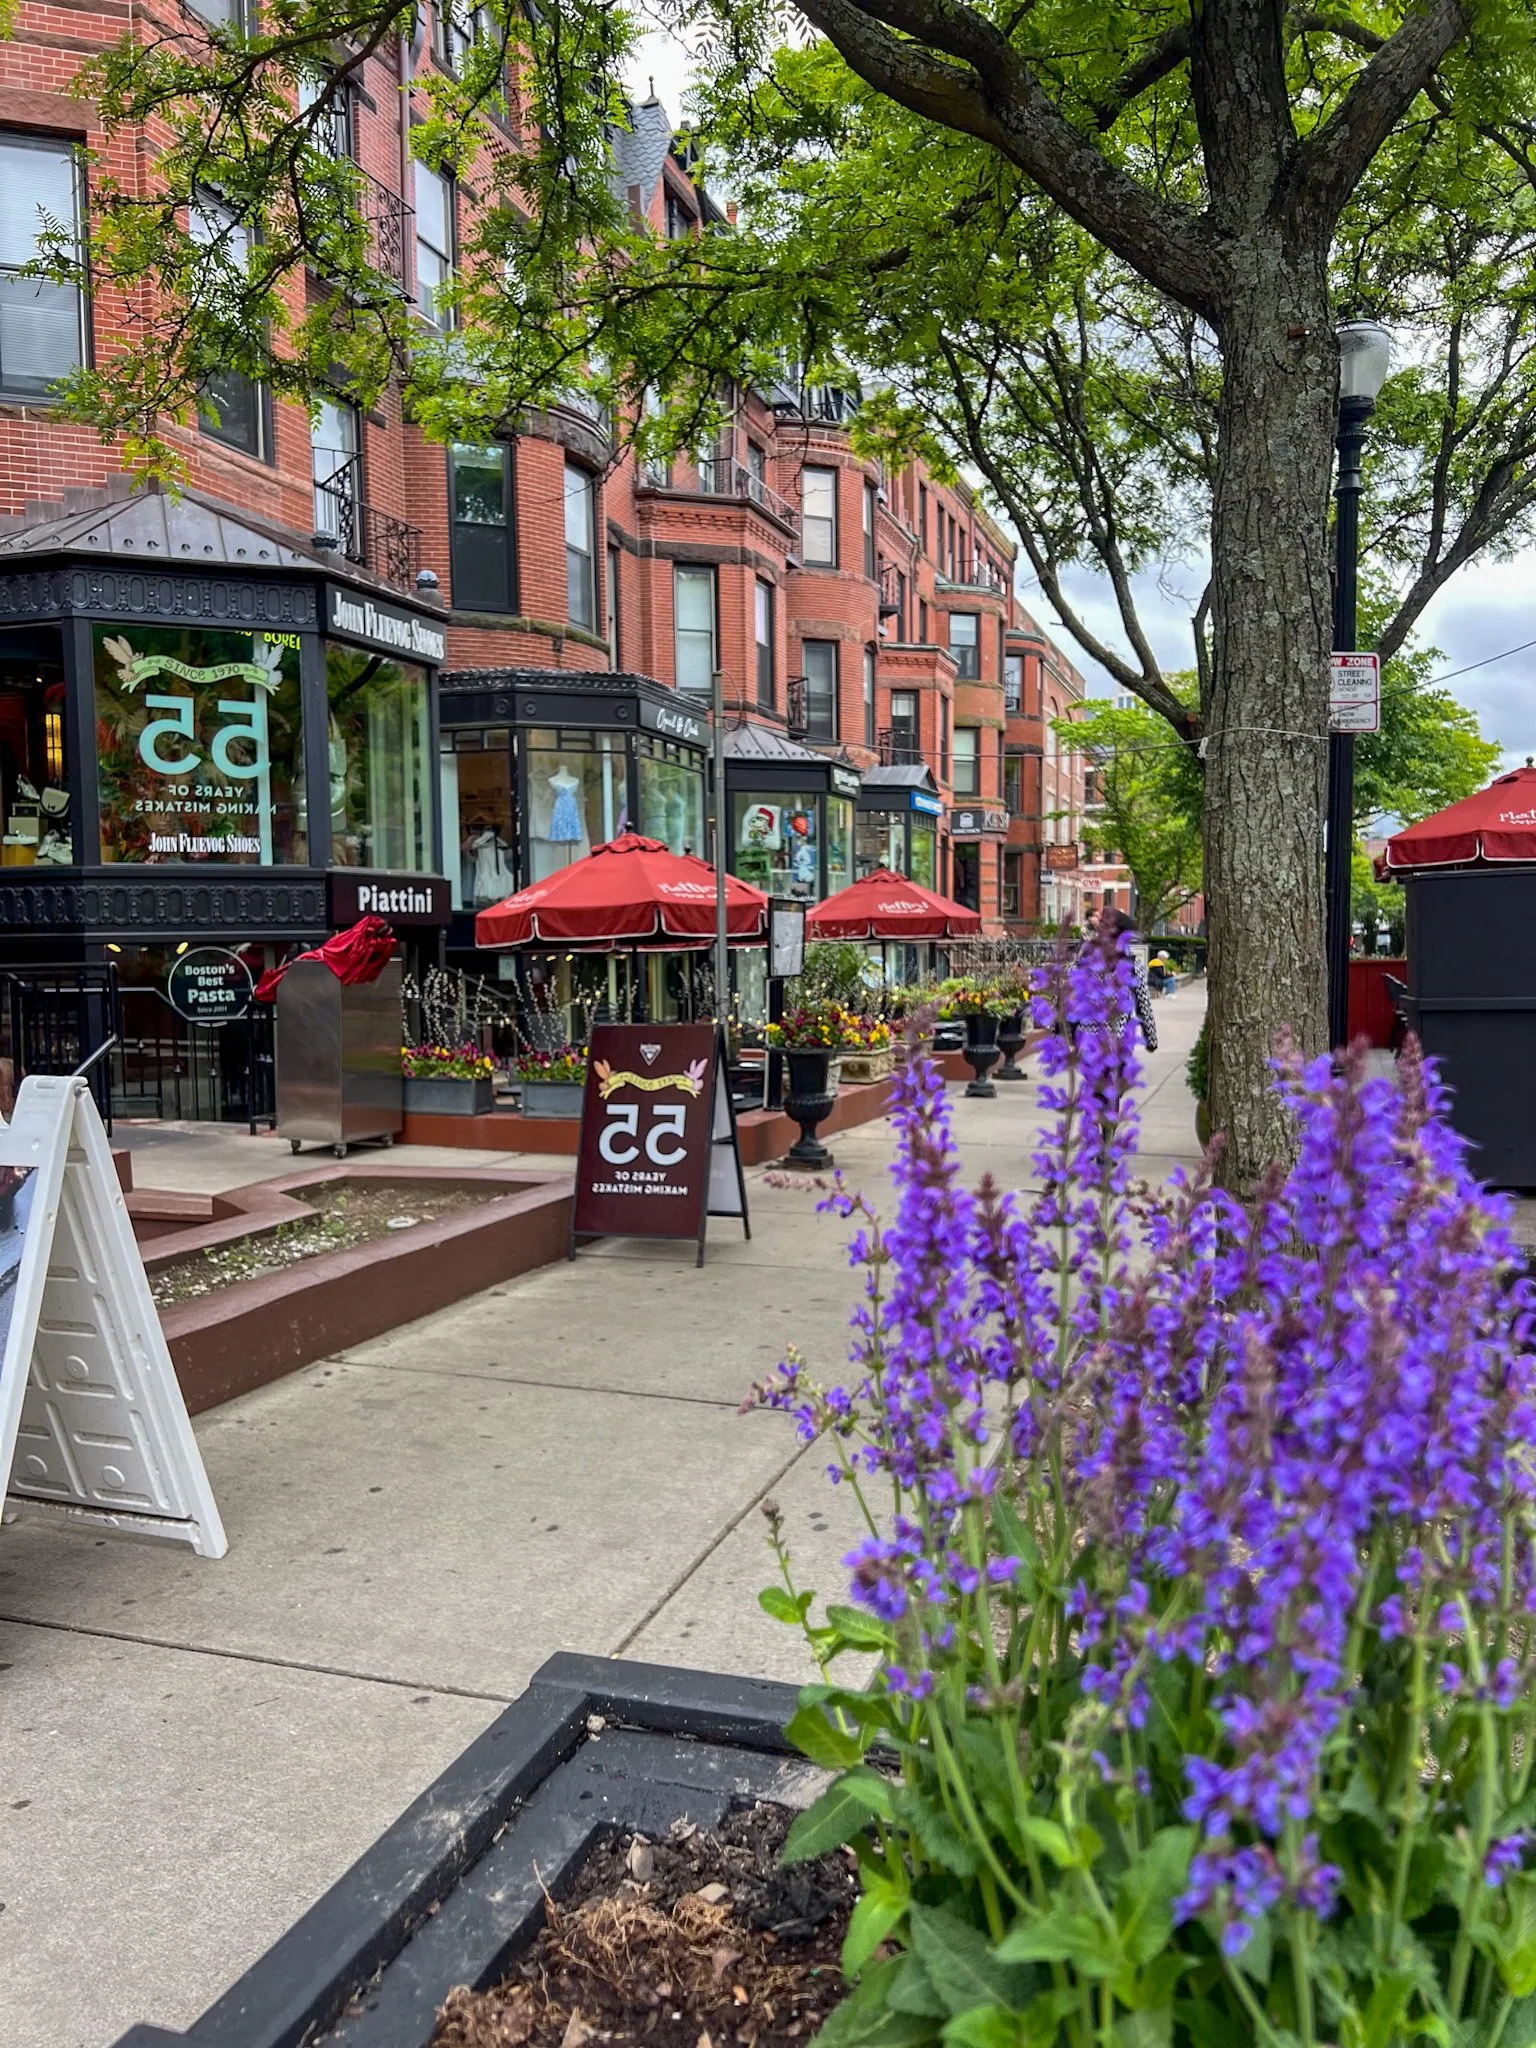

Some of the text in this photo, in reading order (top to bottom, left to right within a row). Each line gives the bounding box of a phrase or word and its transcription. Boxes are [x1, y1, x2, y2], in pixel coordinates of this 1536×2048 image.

[333, 591, 444, 659] JOHN FLUEVOG SHOES
[1346, 657, 1373, 666] ZONE
[212, 664, 239, 678] 1970
[149, 832, 260, 853] JOHN FLUEVOG SHOES
[357, 884, 433, 913] Piattini
[184, 963, 235, 976] Boston's
[197, 976, 224, 987] Best
[187, 988, 236, 1003] Pasta
